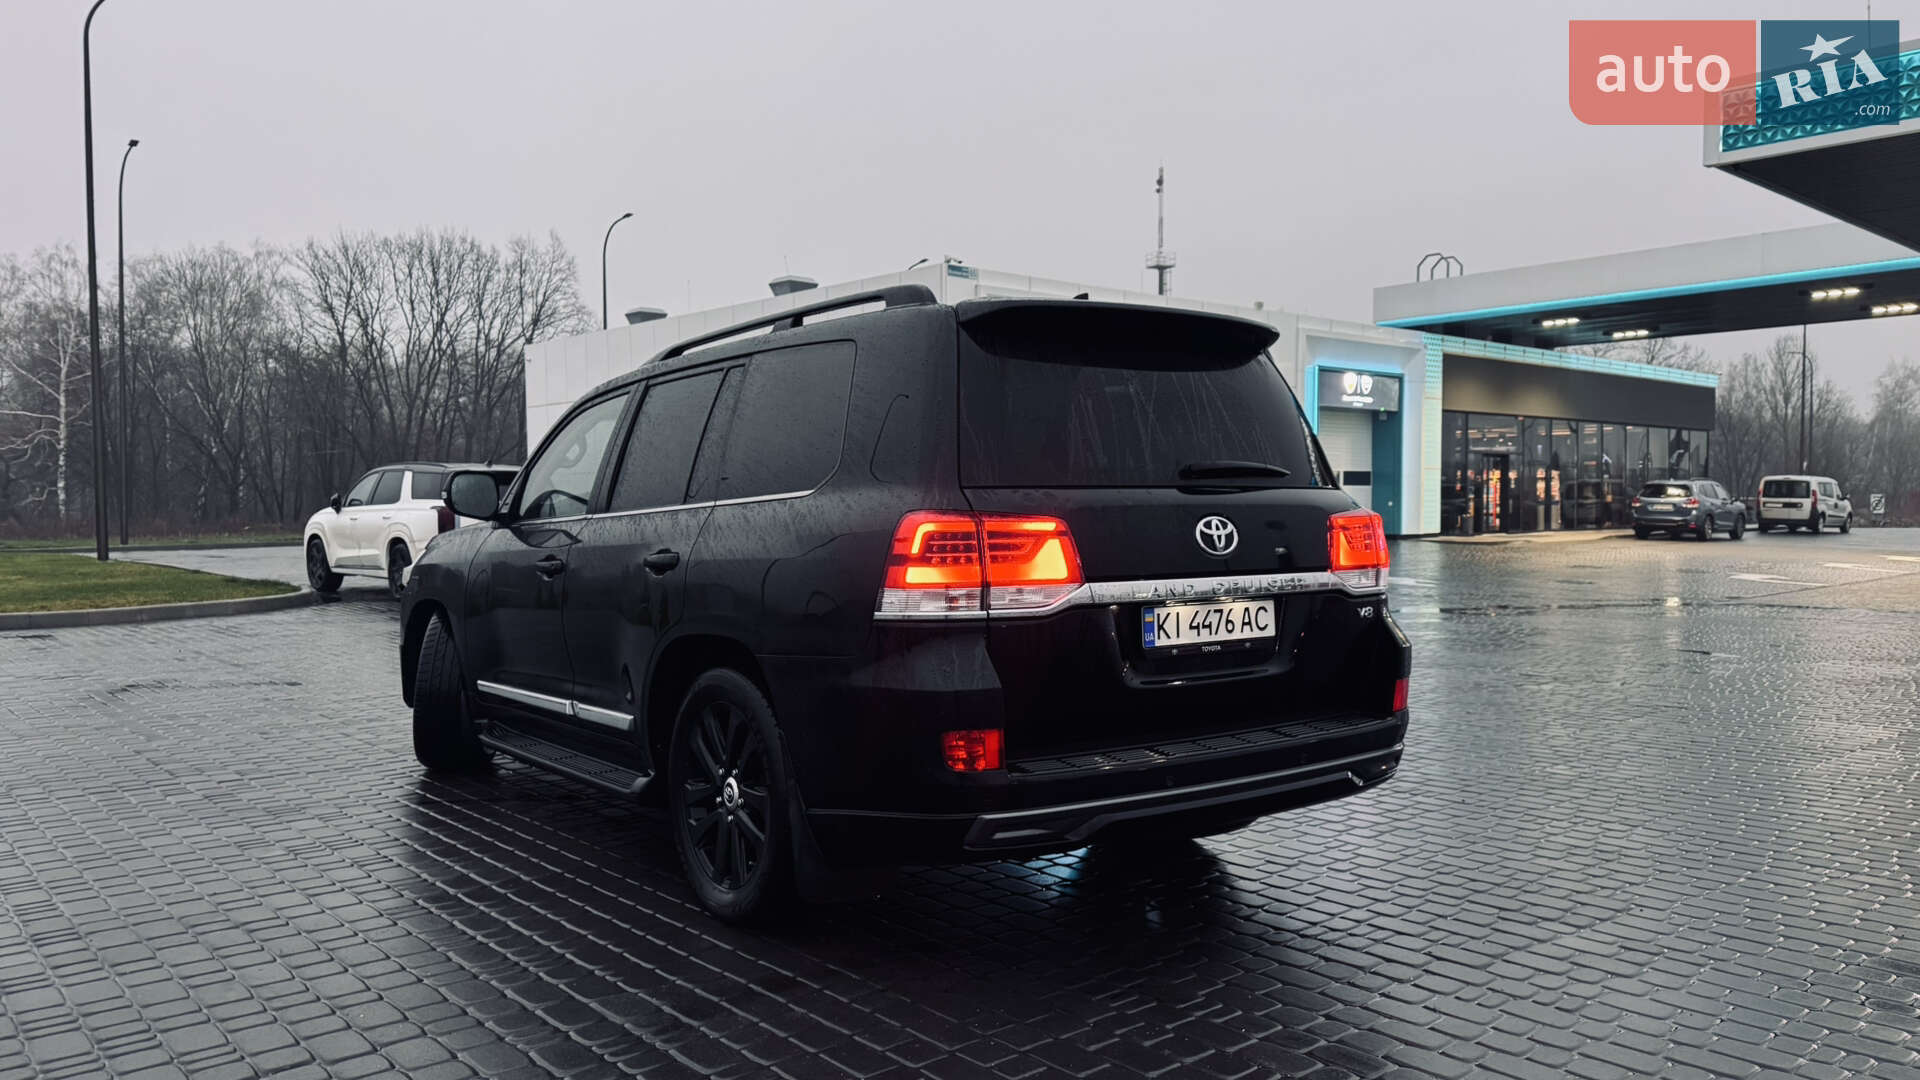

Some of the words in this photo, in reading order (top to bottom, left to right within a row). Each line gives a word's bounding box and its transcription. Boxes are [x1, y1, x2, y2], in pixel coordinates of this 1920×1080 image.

[1357, 606, 1373, 618] V8
[1156, 612, 1181, 640] KI
[1188, 608, 1236, 637] 4476
[1240, 606, 1269, 633] AC
[1145, 632, 1154, 641] UA
